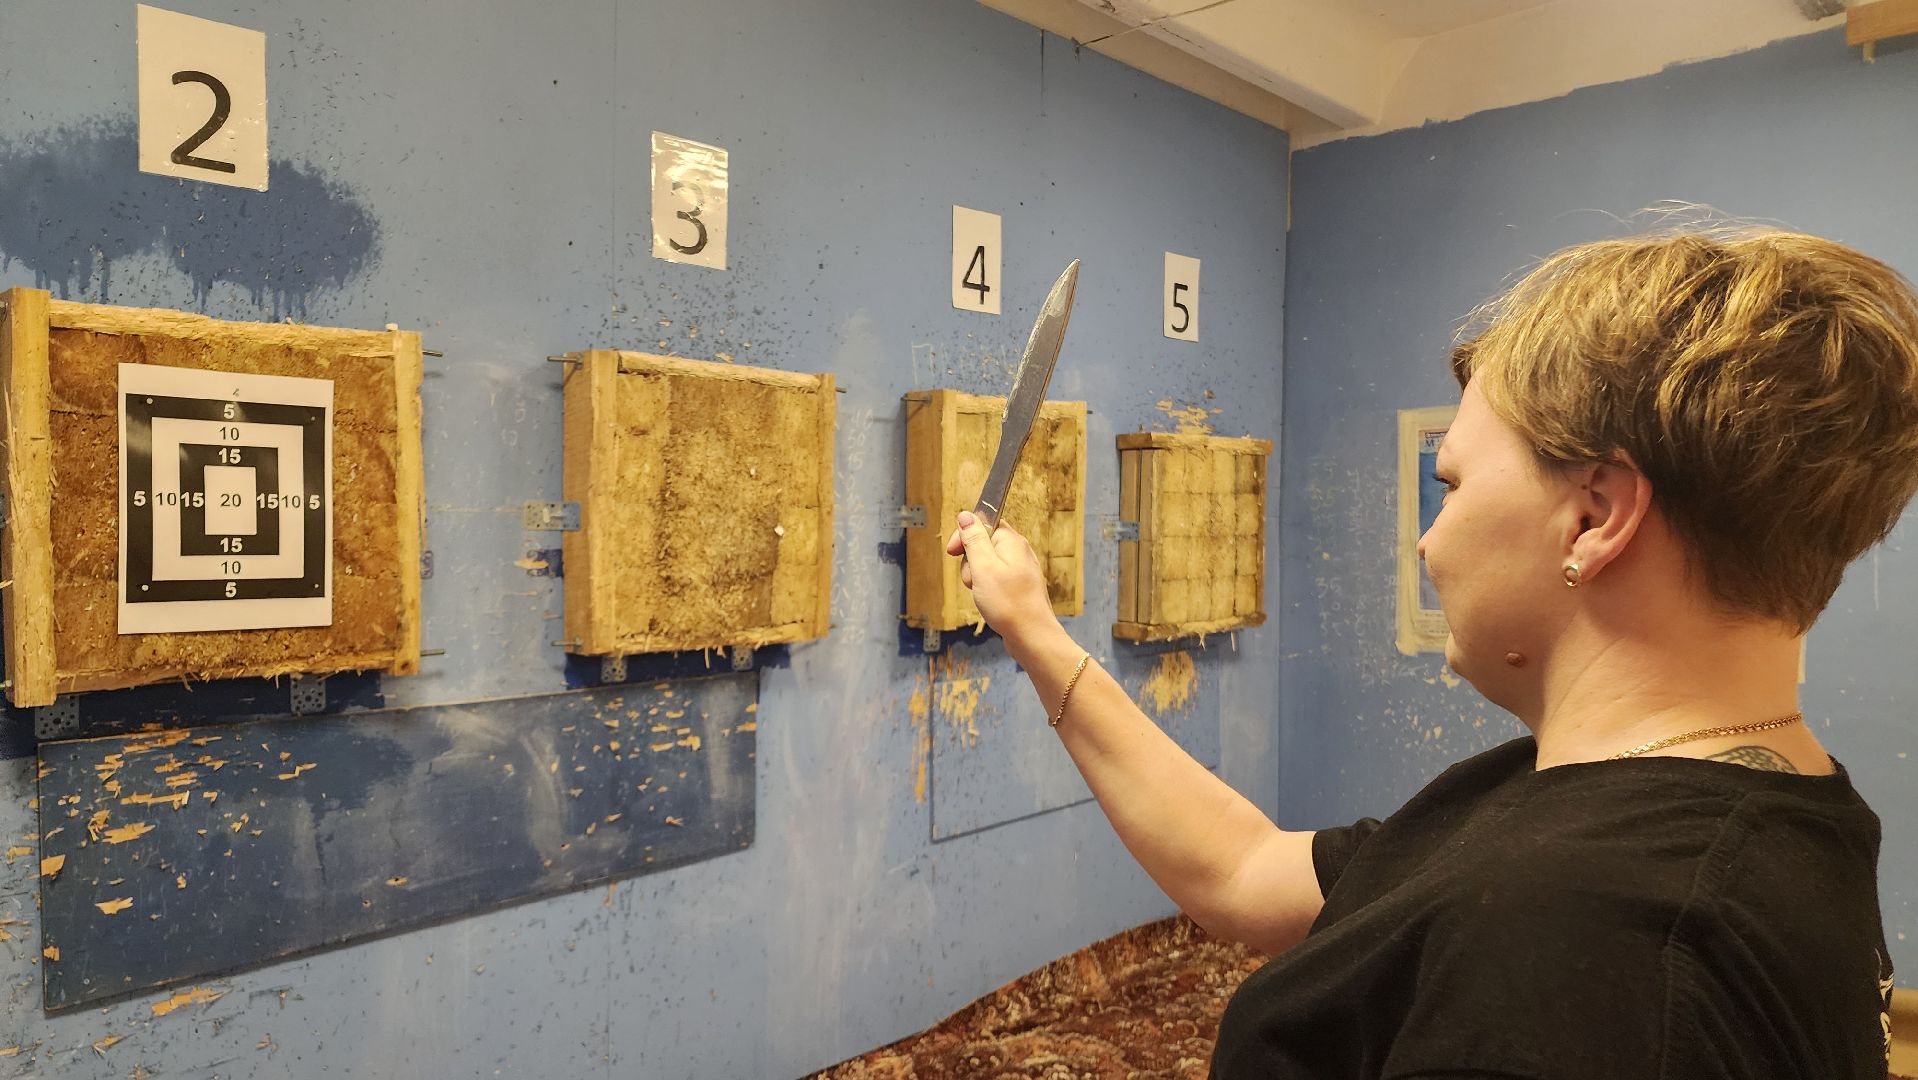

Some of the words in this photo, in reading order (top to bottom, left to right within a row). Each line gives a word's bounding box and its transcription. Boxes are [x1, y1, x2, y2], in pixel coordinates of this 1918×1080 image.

[170, 70, 235, 174] 2
[668, 179, 709, 256] 3
[961, 245, 991, 305] 4
[1171, 282, 1190, 333] 5
[223, 403, 235, 419] 5
[219, 426, 240, 441] 10
[218, 448, 241, 464] 15
[134, 491, 146, 507] 5
[156, 492, 177, 506] 10
[181, 492, 205, 508] 15
[220, 493, 242, 507] 20
[256, 493, 279, 509] 15
[281, 494, 301, 509] 10
[309, 494, 320, 510] 5
[220, 538, 243, 554] 15
[221, 560, 241, 575] 10
[225, 581, 237, 598] 5
